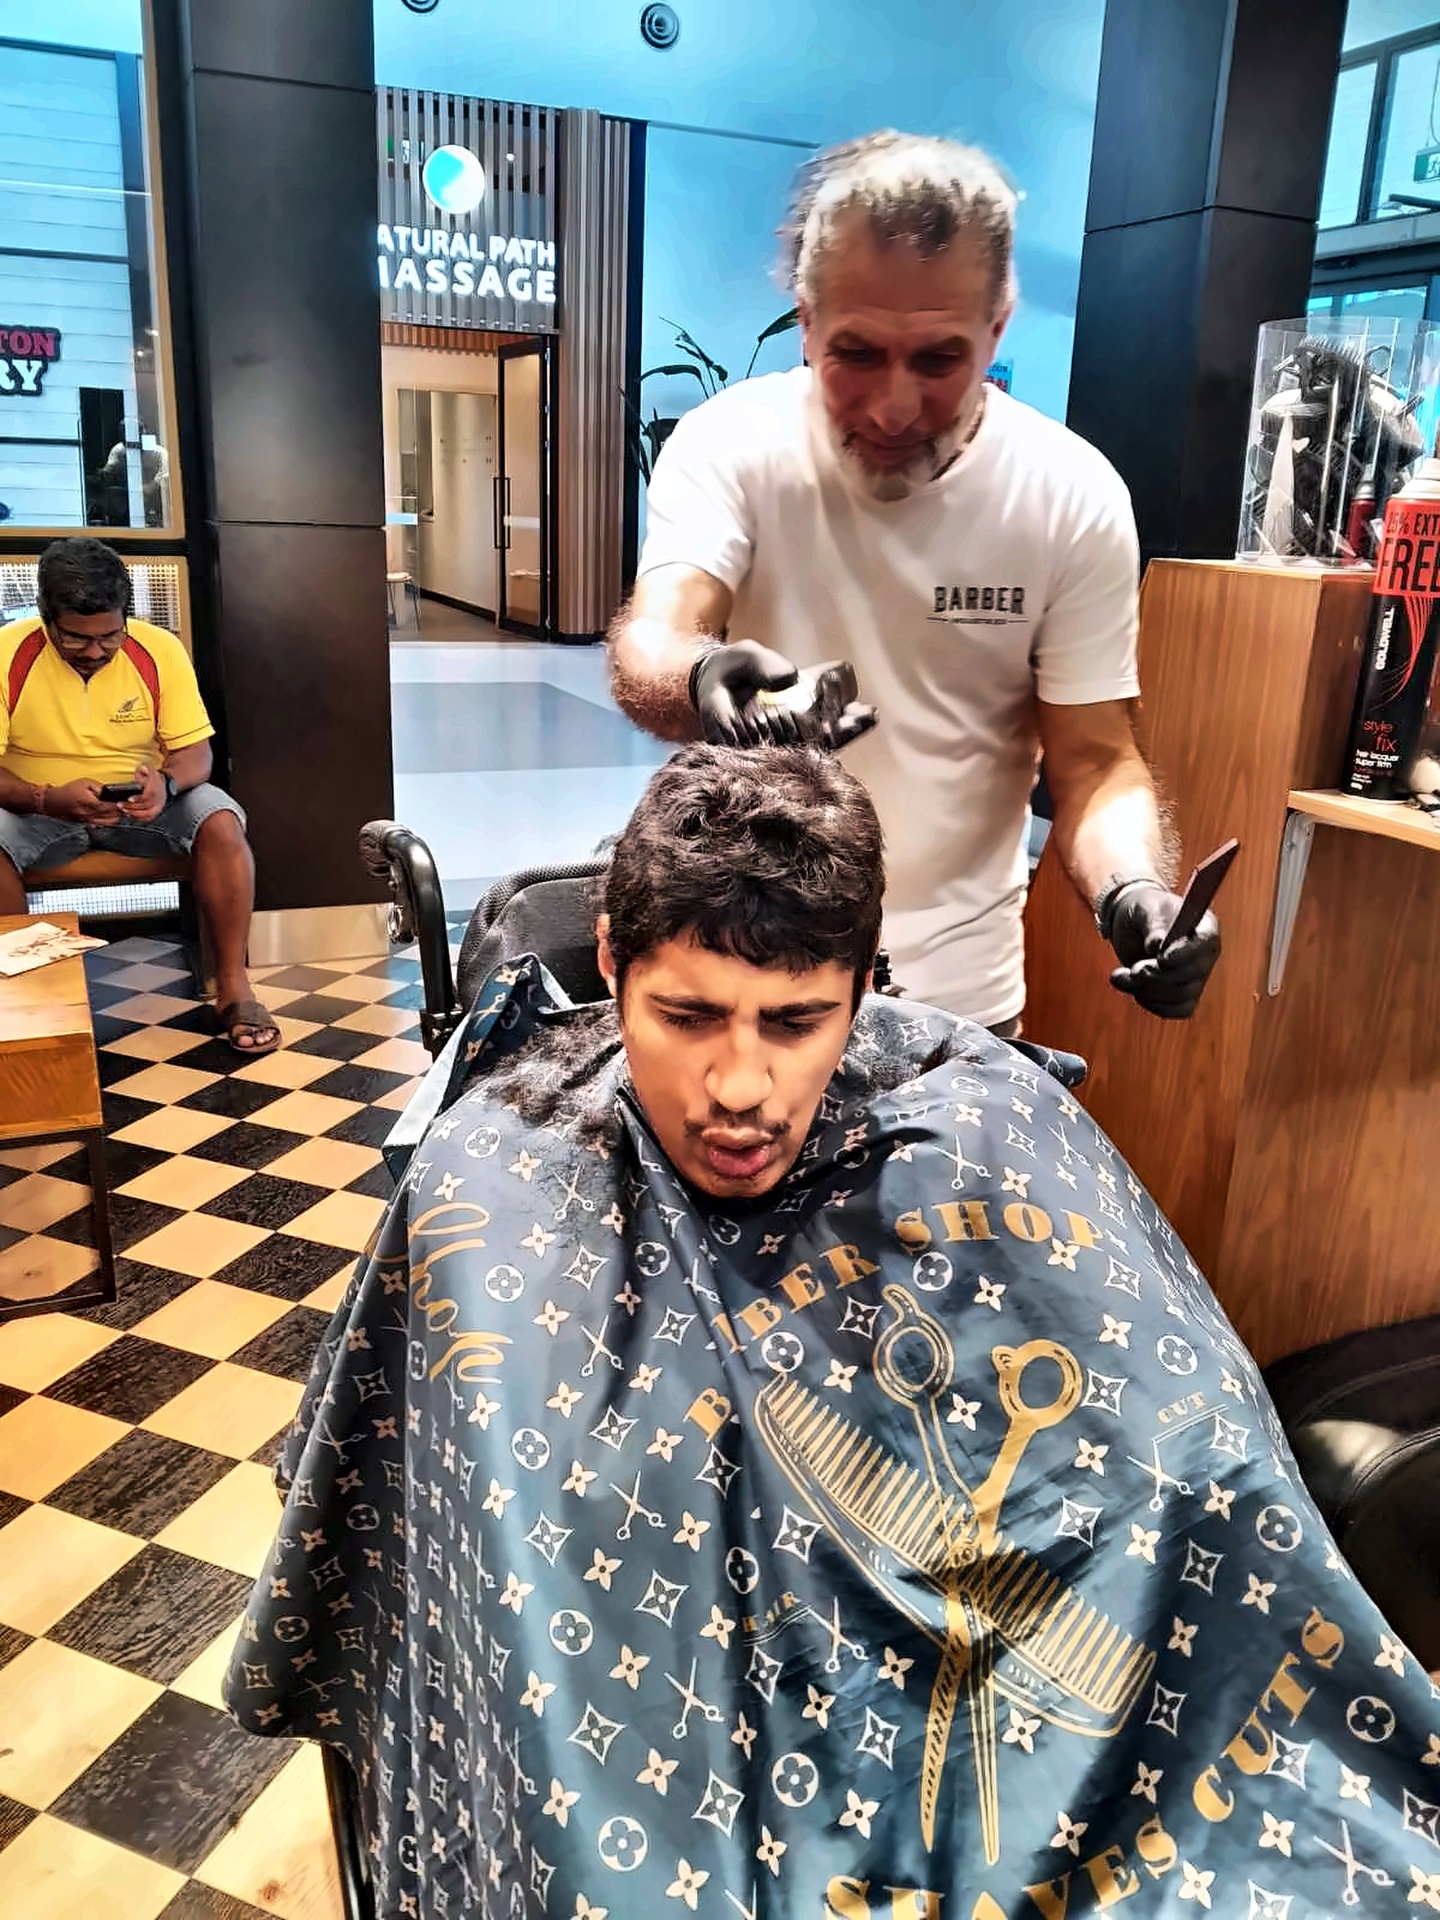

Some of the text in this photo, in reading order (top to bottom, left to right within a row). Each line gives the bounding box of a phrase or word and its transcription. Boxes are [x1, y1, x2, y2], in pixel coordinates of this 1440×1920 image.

[489, 235, 556, 267] PATH
[933, 586, 1025, 615] BARBER
[894, 1200, 1105, 1254] SHOP
[1193, 1606, 1345, 1823] CUTS
